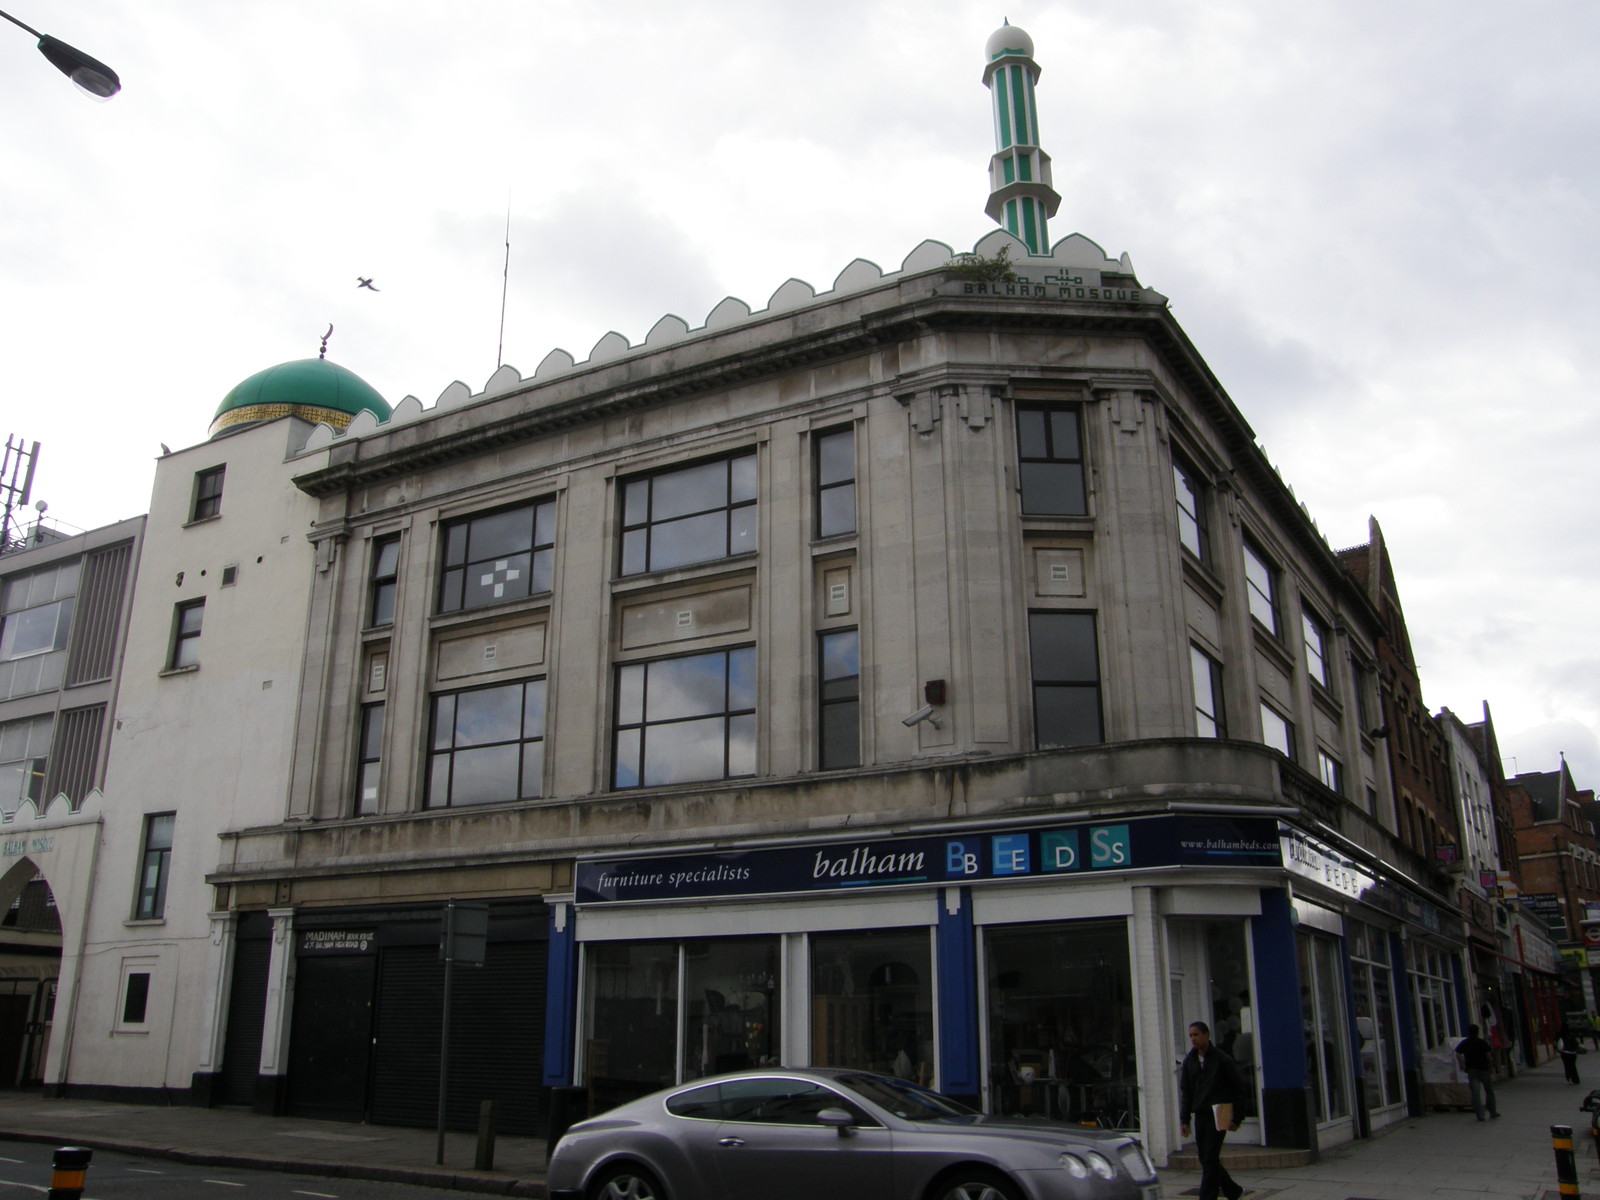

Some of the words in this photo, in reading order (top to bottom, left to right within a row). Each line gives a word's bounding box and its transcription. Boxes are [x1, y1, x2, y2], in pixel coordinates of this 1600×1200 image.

[963, 283, 1047, 297] BALHAM
[1059, 287, 1141, 301] MOSQUE
[1180, 838, 1280, 851] www.balhambeds.com
[597, 871, 663, 893] furniture
[668, 865, 751, 888] specialists
[813, 846, 925, 879] balham
[306, 931, 346, 941] MADINAH
